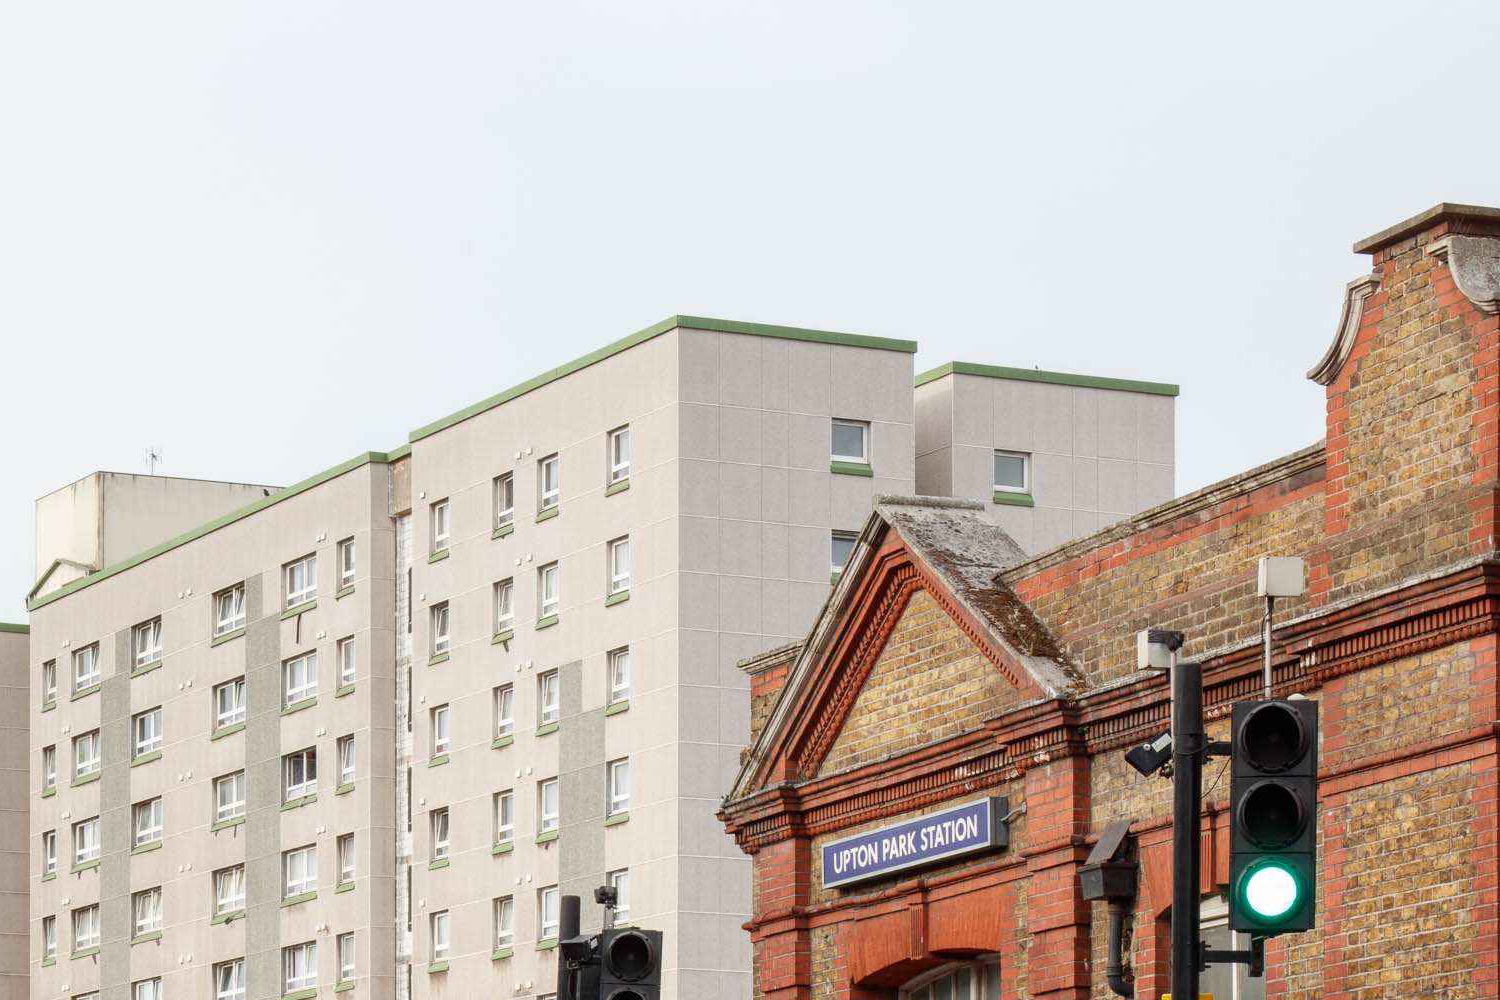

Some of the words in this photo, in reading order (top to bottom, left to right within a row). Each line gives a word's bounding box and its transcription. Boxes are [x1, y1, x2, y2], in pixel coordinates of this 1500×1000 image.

[833, 841, 879, 875] UPTON
[882, 831, 917, 862] PARK
[920, 814, 979, 852] STATION
